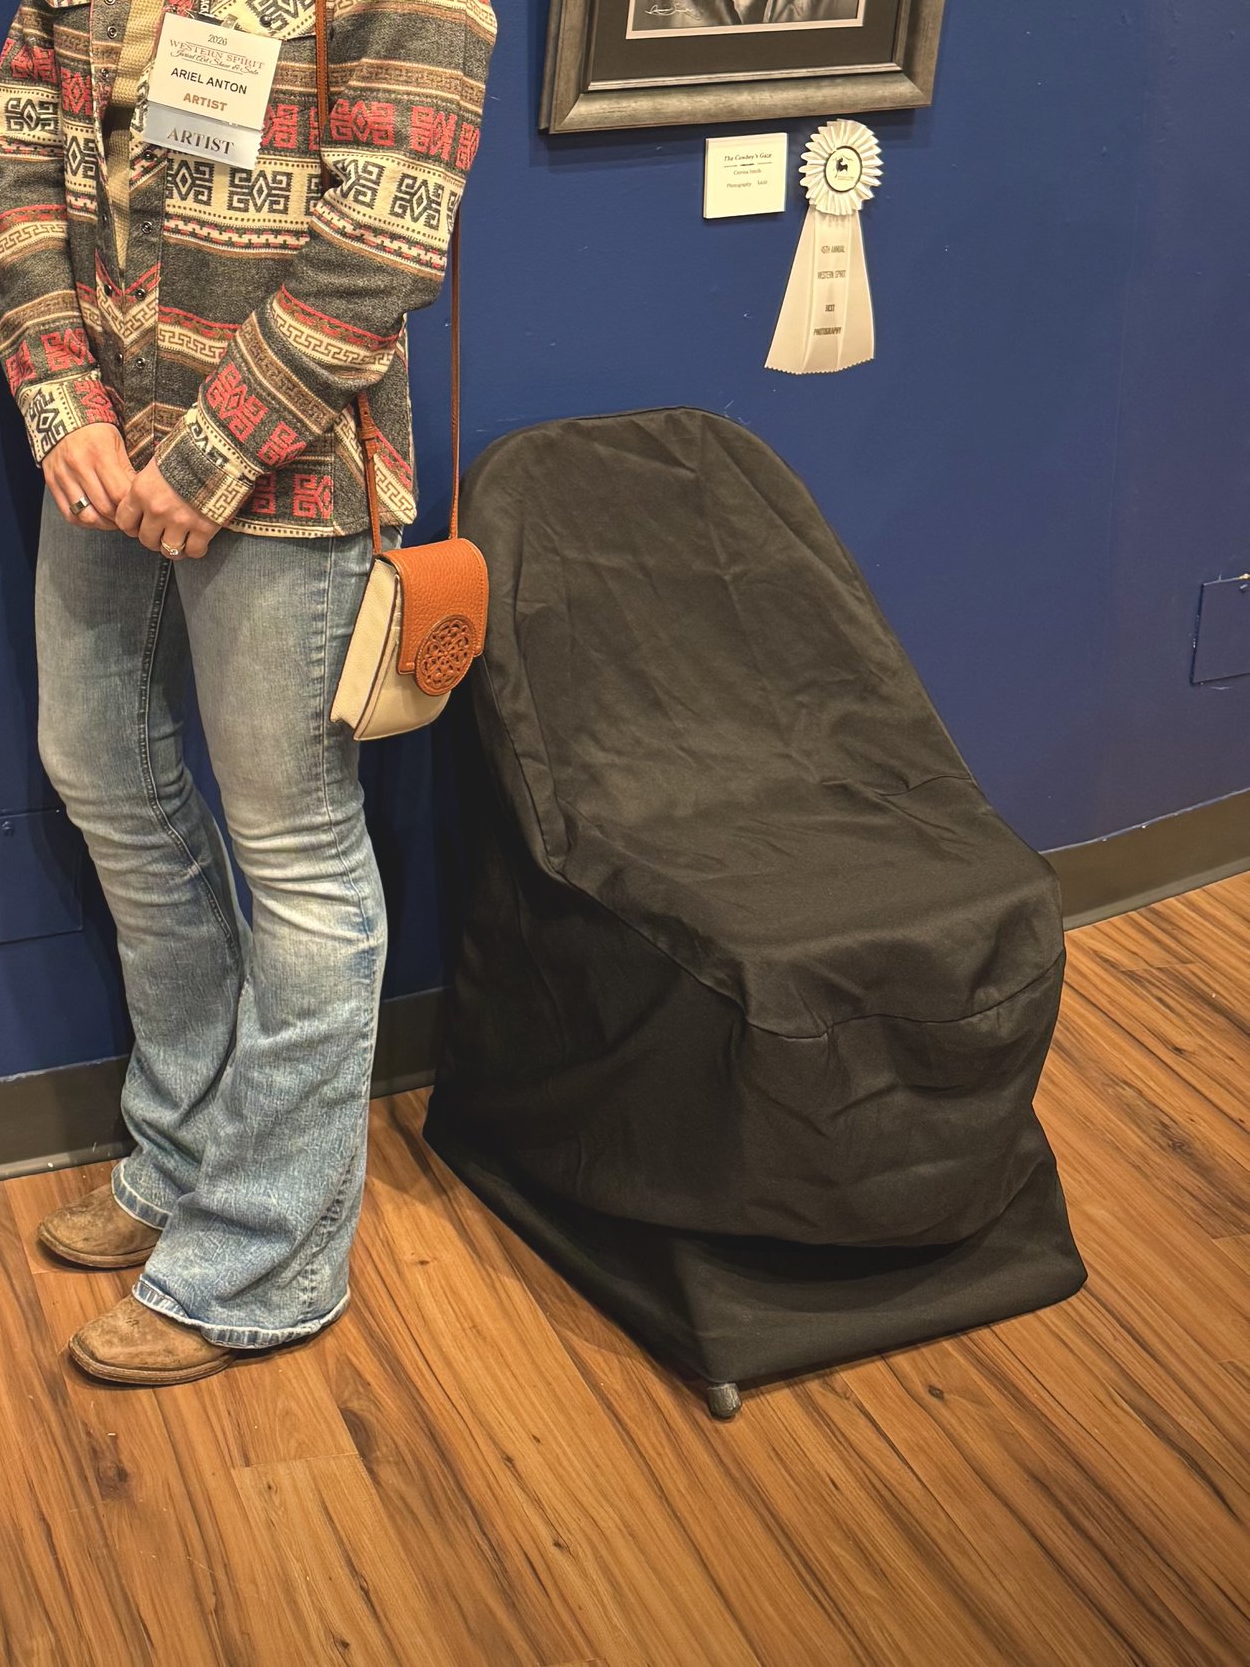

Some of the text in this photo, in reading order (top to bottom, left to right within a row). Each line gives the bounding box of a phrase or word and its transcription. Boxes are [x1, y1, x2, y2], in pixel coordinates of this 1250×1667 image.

[170, 39, 265, 69] WESTERN SPIRIT
[207, 34, 228, 46] 2026
[170, 67, 248, 95] ARIEL ANTON
[183, 92, 228, 112] ARTIST
[167, 126, 235, 155] ARTIST
